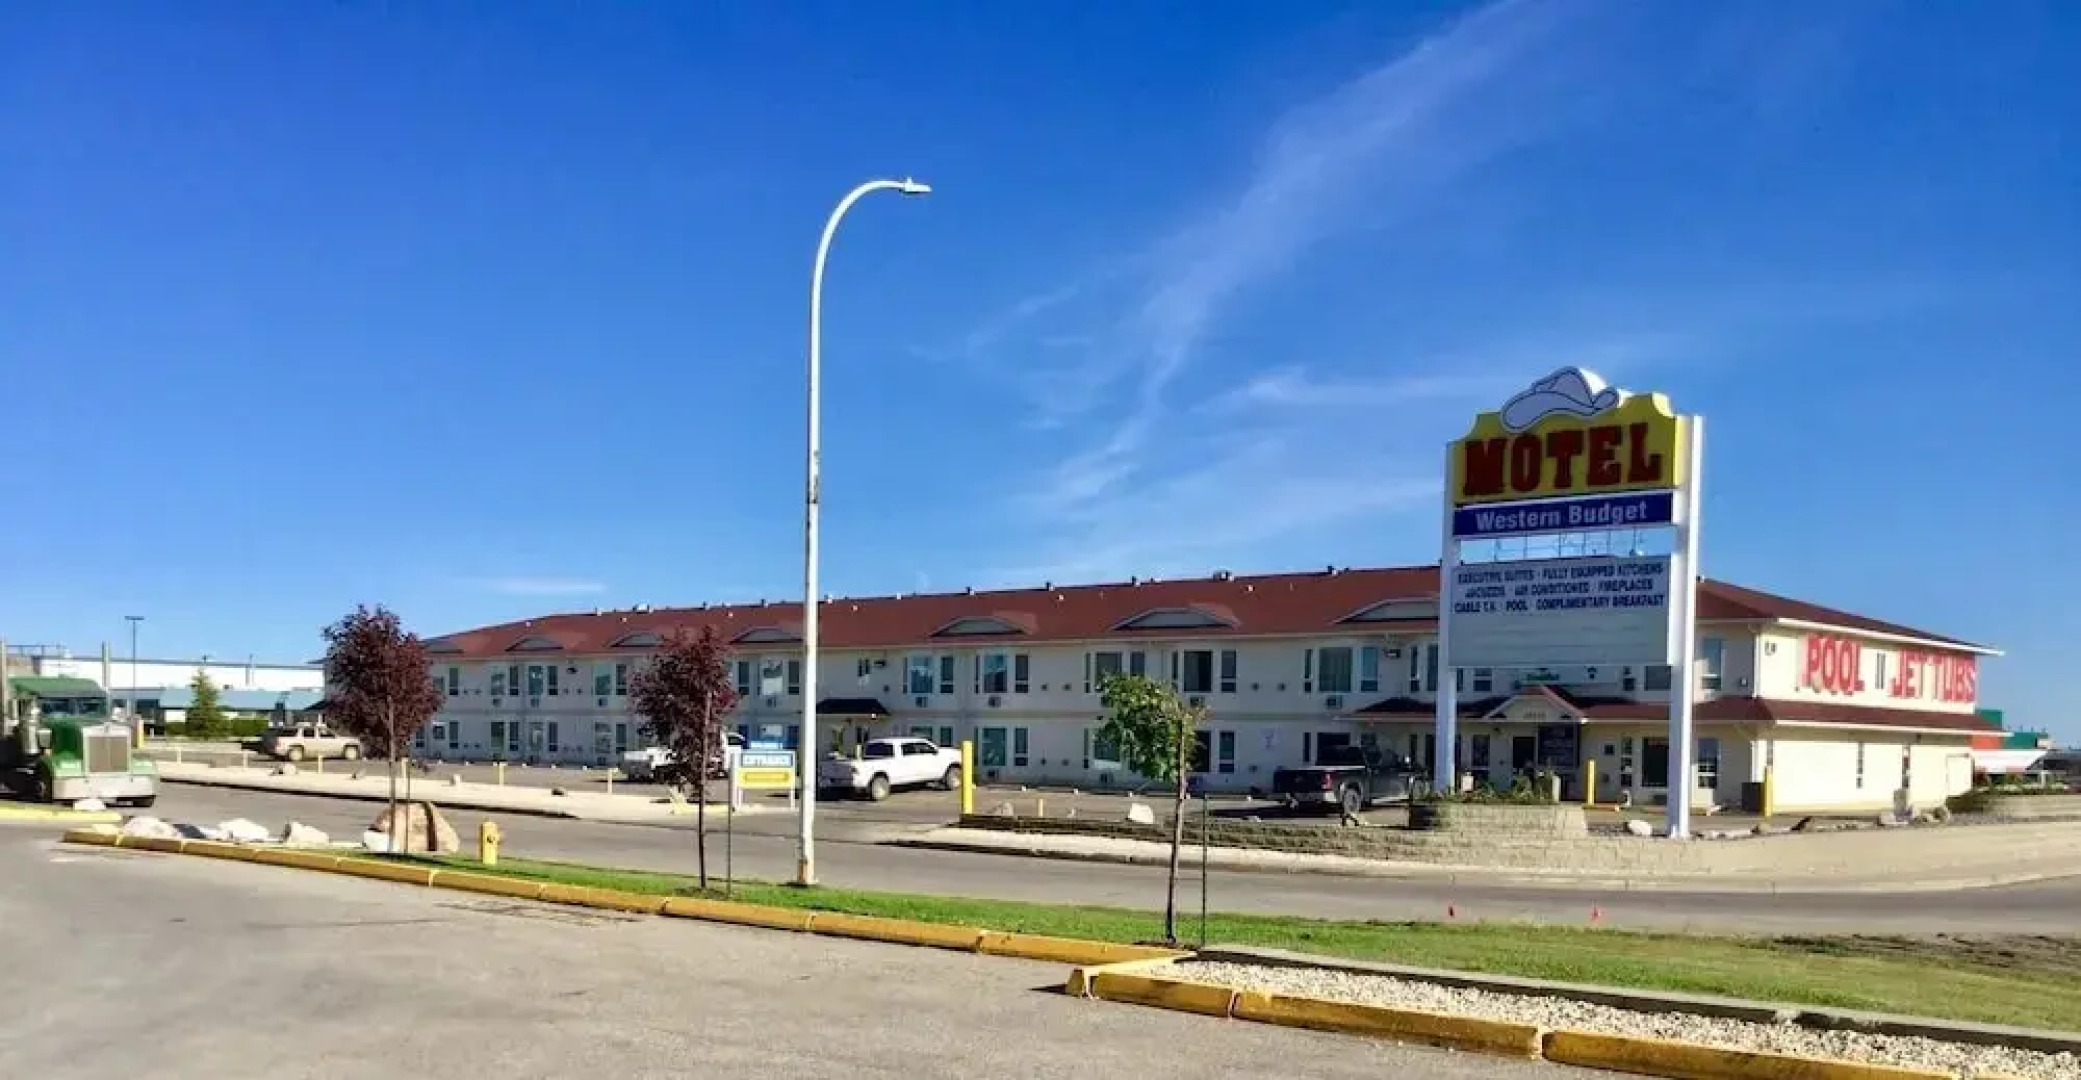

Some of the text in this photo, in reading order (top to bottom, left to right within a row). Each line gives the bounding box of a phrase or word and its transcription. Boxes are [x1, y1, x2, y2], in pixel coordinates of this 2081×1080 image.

[1463, 422, 1662, 496] MOTEL
[1475, 500, 1648, 532] Western Budget
[1454, 601, 1480, 613] CABLE
[1506, 599, 1528, 612] POOL
[1612, 593, 1664, 607] BREAKFAST
[1598, 578, 1653, 592] FIREPLACES
[1802, 633, 1864, 694] POOL
[1892, 648, 1976, 703] JET TUBS
